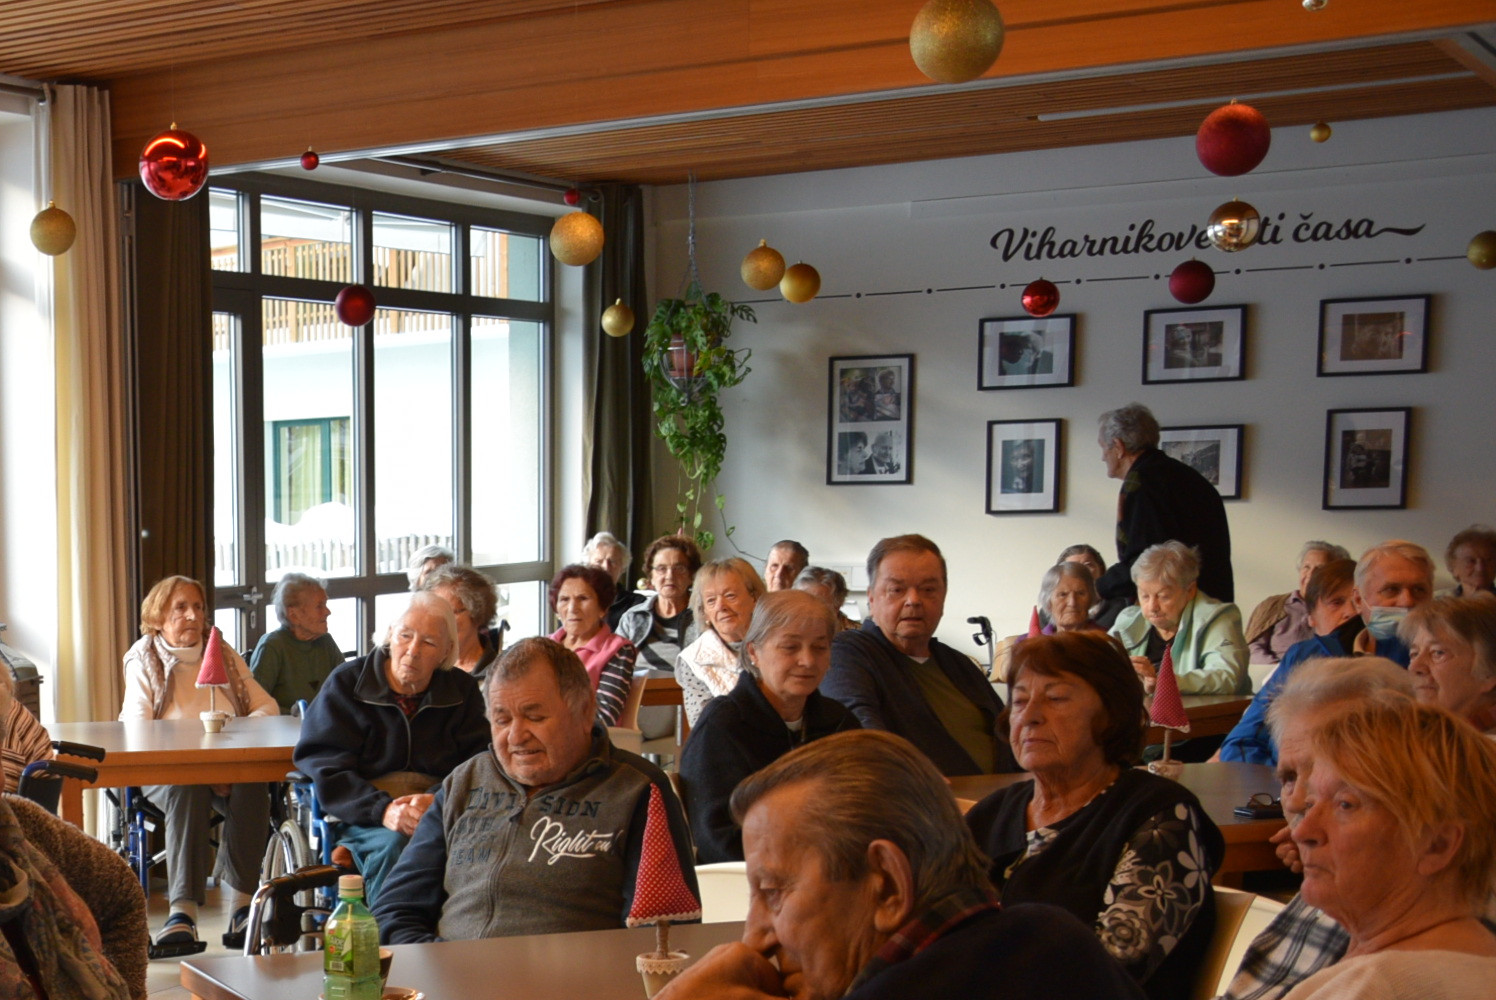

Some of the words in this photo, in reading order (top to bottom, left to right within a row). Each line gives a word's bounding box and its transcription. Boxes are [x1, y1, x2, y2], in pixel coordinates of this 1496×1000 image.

[990, 218, 1212, 262] Viharnikove
[1292, 212, 1418, 243] časa
[527, 815, 614, 866] Right
